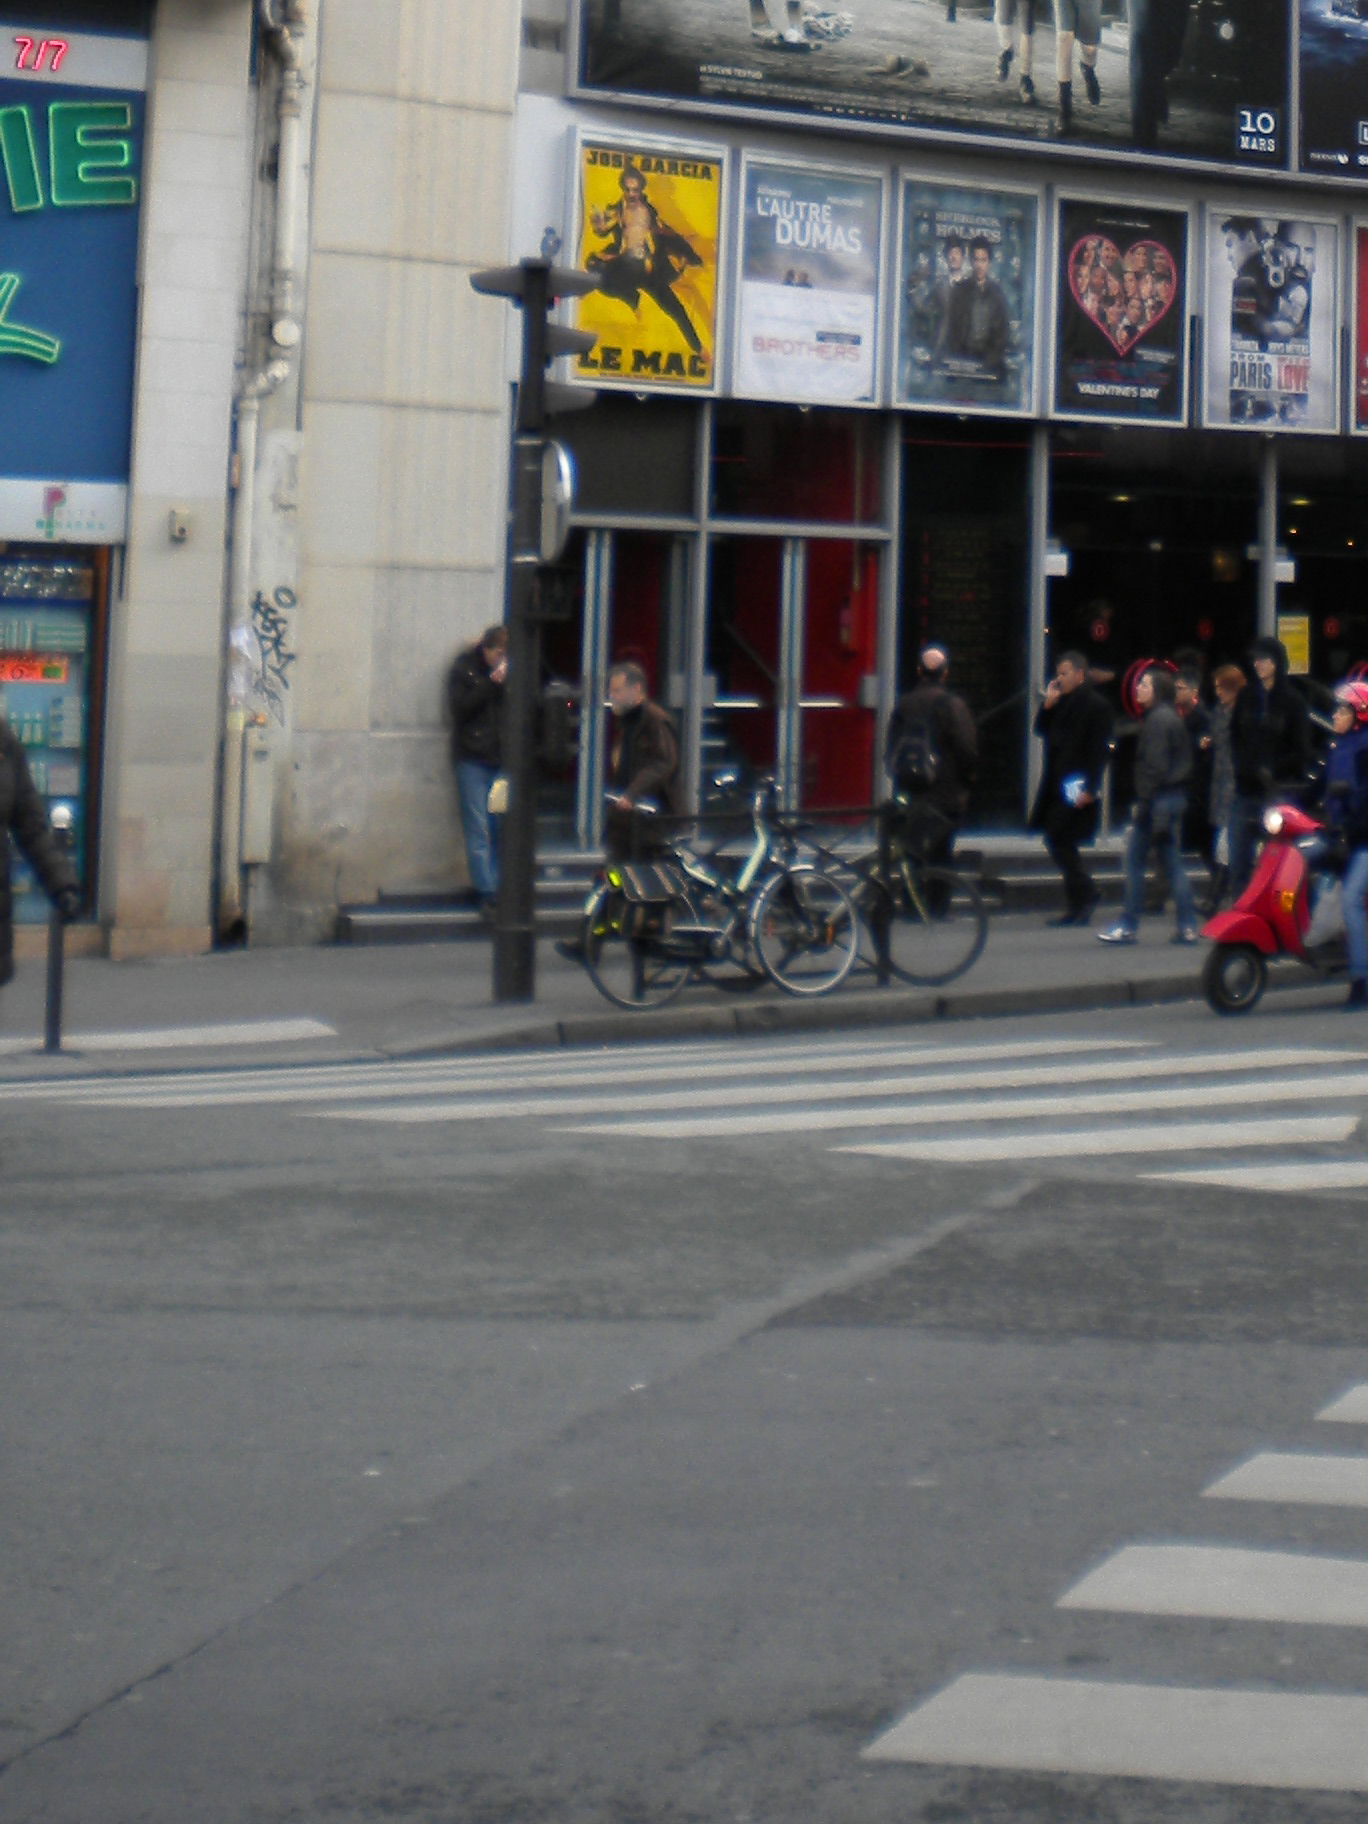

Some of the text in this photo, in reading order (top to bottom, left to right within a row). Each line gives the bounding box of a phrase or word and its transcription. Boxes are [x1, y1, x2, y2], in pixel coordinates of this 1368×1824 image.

[15, 37, 68, 71] 7/7
[1240, 110, 1275, 134] 10
[1240, 136, 1275, 152] MARS
[642, 155, 712, 181] GARCIA
[757, 197, 832, 224] L'AUTRE
[776, 218, 862, 254] DUMAS
[579, 347, 622, 370] LE
[1230, 361, 1272, 390] PARIS
